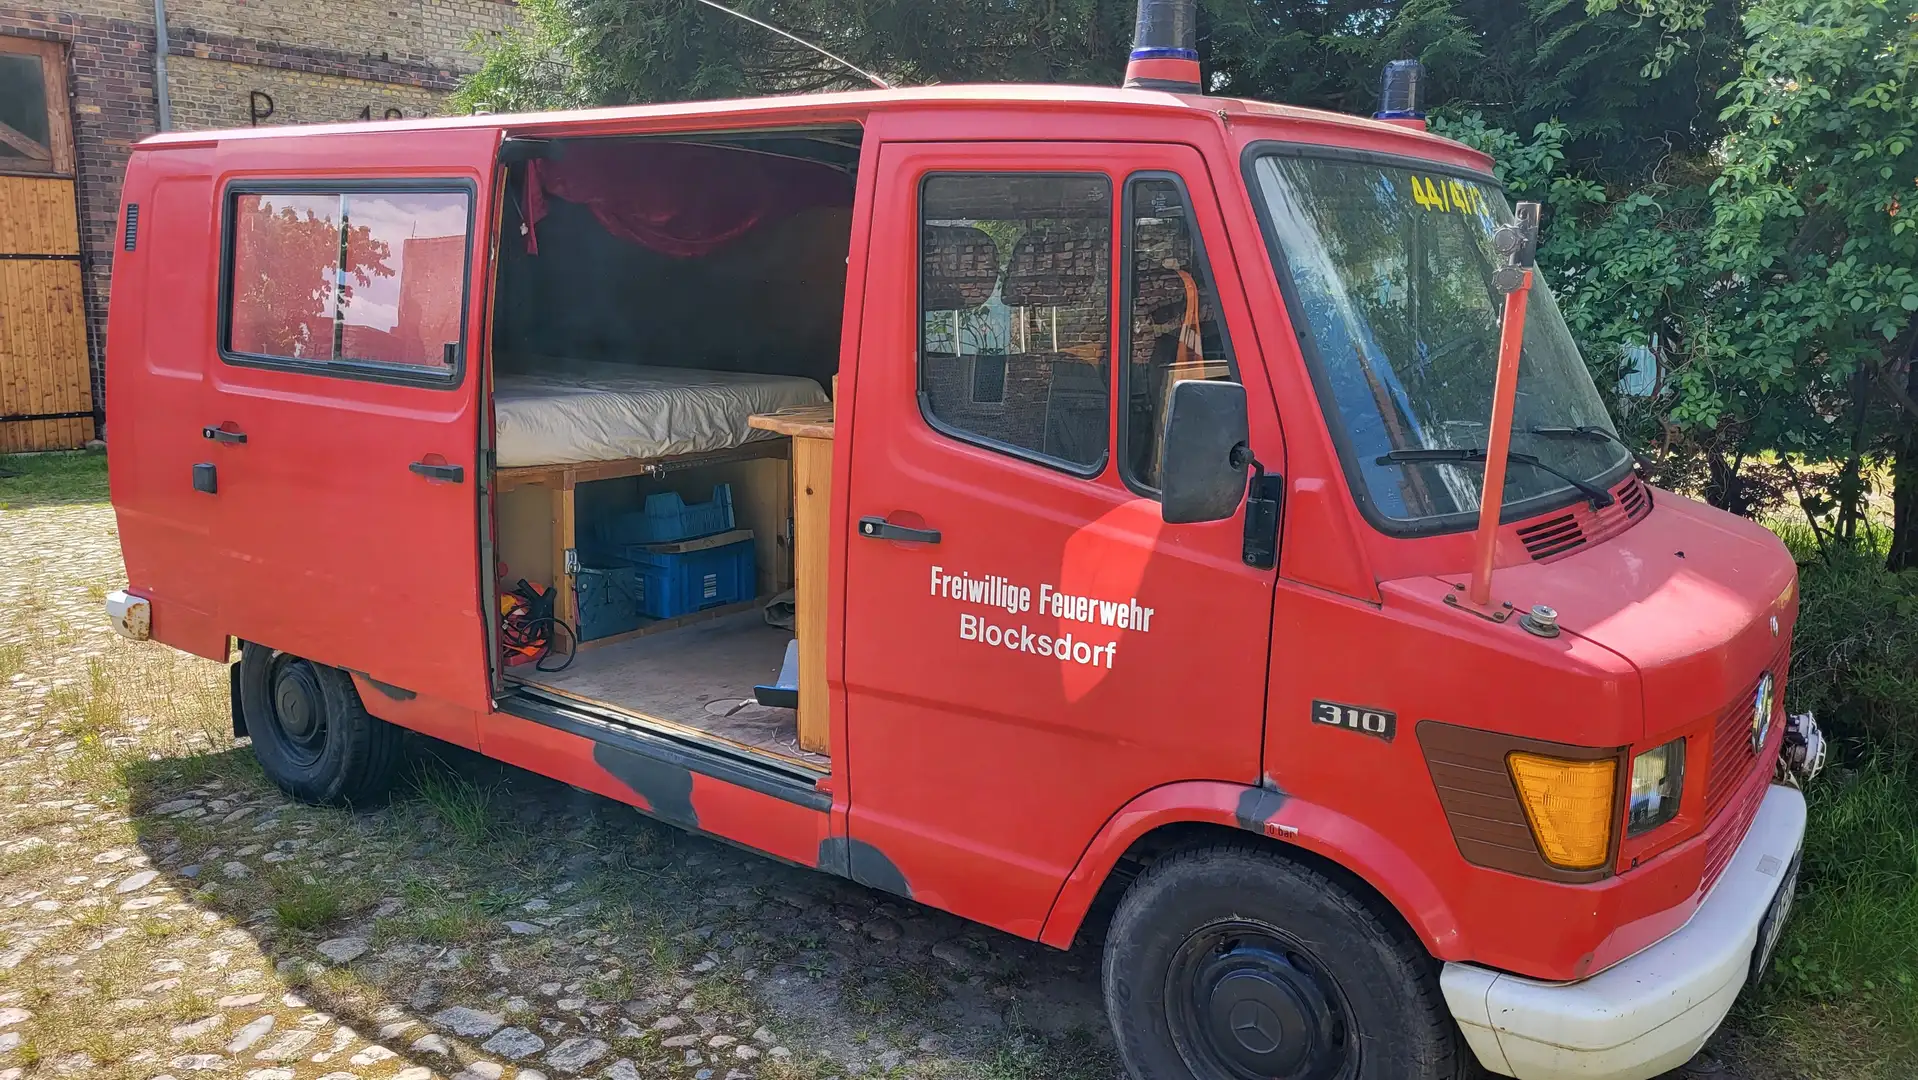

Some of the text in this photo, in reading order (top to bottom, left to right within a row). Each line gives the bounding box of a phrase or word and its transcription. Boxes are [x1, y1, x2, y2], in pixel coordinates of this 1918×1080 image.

[930, 565, 1154, 632] Freiwillige Feuerwehr
[960, 613, 1117, 669] Blocksdorf
[1318, 704, 1386, 733] 310
